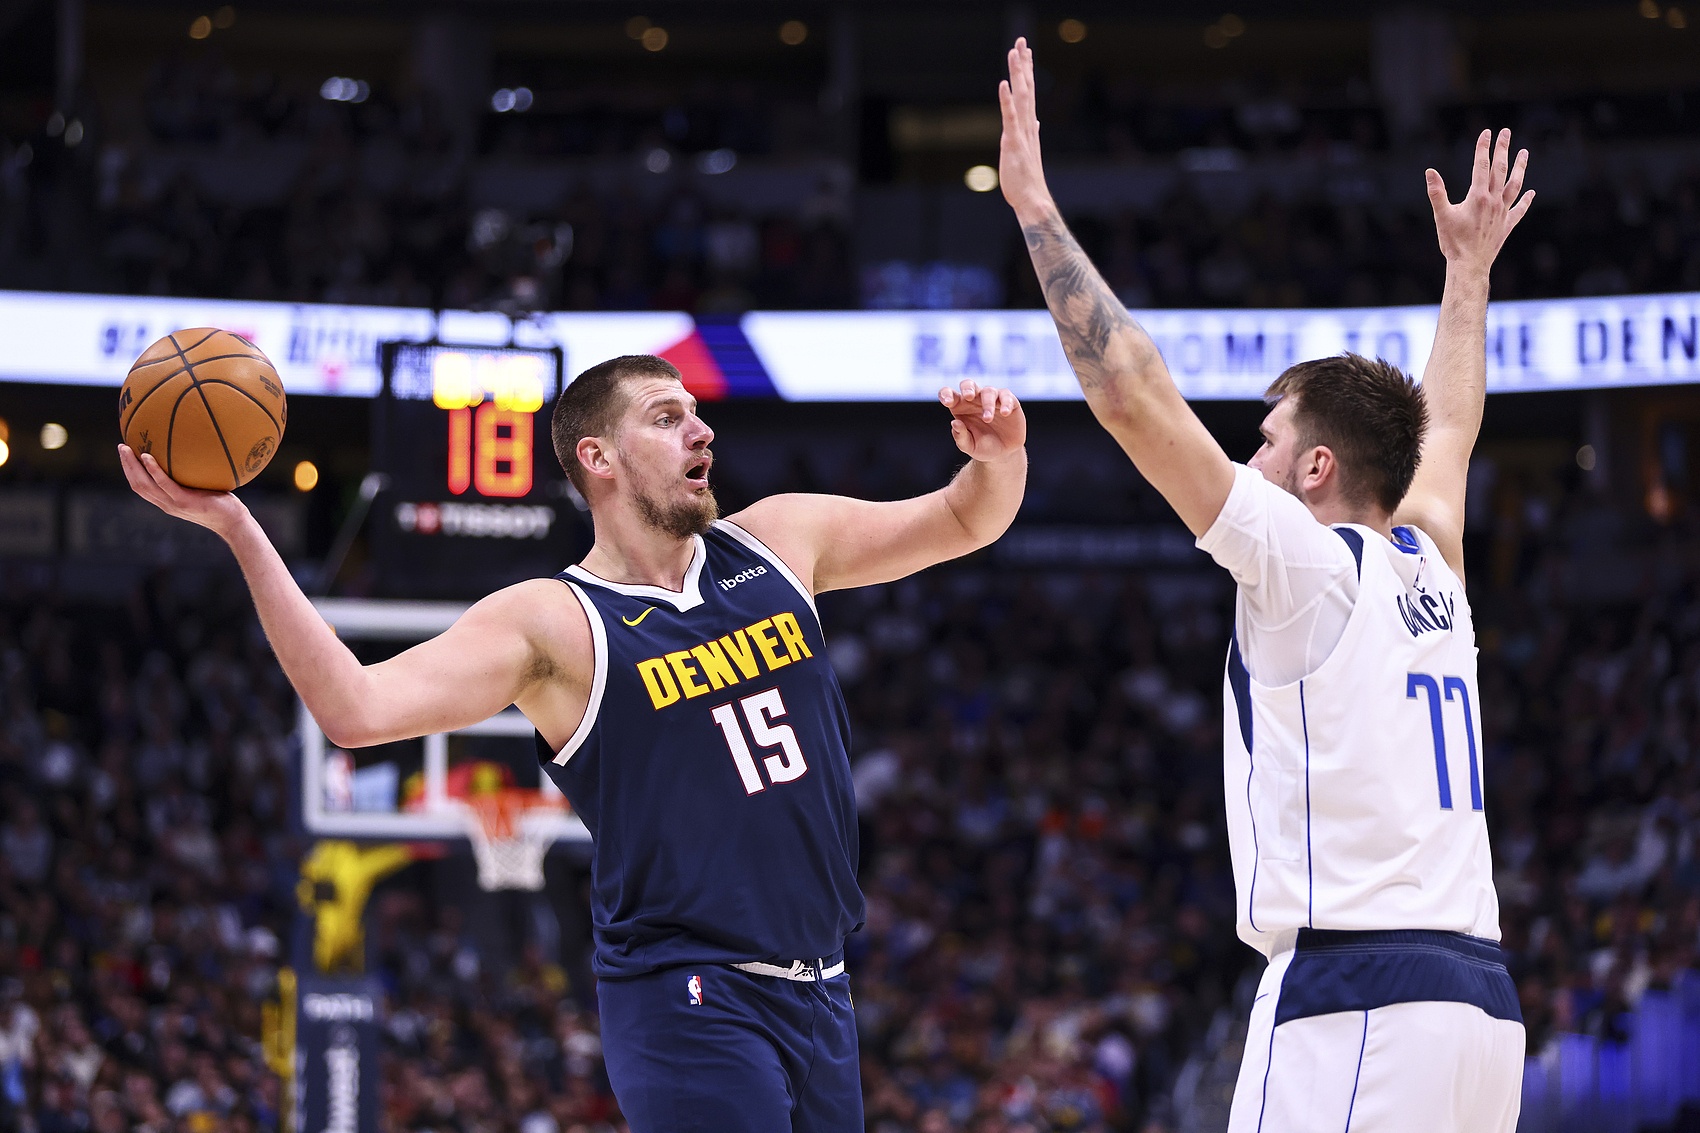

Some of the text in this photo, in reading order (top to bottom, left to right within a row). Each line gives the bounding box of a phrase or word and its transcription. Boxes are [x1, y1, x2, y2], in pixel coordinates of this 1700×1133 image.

[916, 333, 1058, 375] RADI
[448, 402, 534, 498] 18
[717, 563, 767, 591] ibotta
[635, 611, 814, 711] DENVER
[709, 685, 809, 797] 15
[1406, 671, 1483, 812] 77
